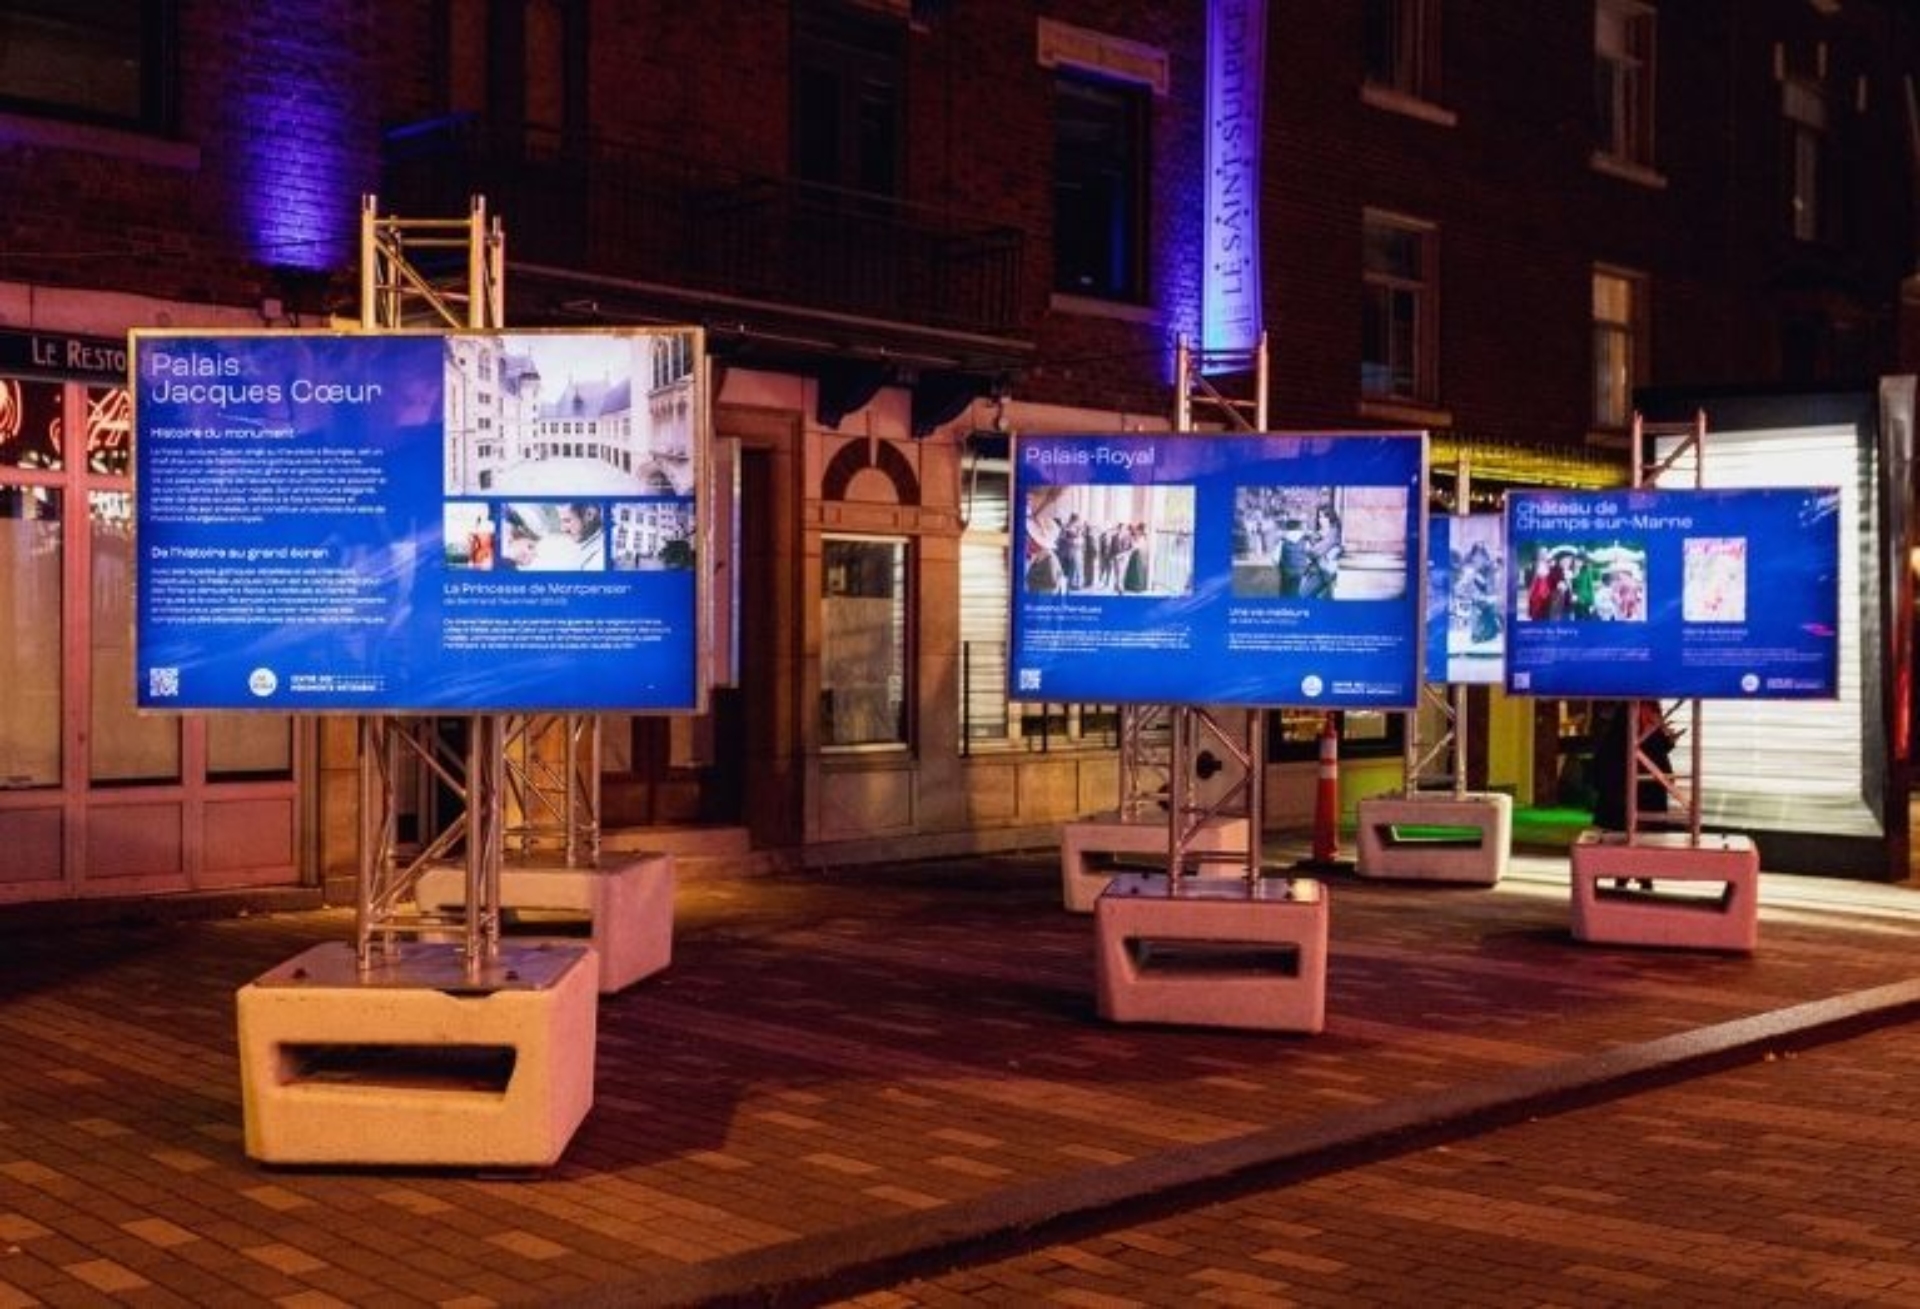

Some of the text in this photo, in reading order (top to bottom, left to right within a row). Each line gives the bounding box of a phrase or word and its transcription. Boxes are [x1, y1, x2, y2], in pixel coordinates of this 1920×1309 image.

[1222, 257, 1243, 296] LE
[152, 352, 241, 377] Palais
[151, 379, 382, 409] Jacques Cœur
[151, 427, 295, 439] Histoire du monument
[1024, 446, 1156, 470] Palais-Royal
[1516, 499, 1618, 516] Château de
[1516, 516, 1694, 532] Champs-sur-Marne
[151, 546, 169, 559] De
[247, 546, 288, 561] grand
[443, 582, 459, 595] La
[528, 582, 546, 595] de
